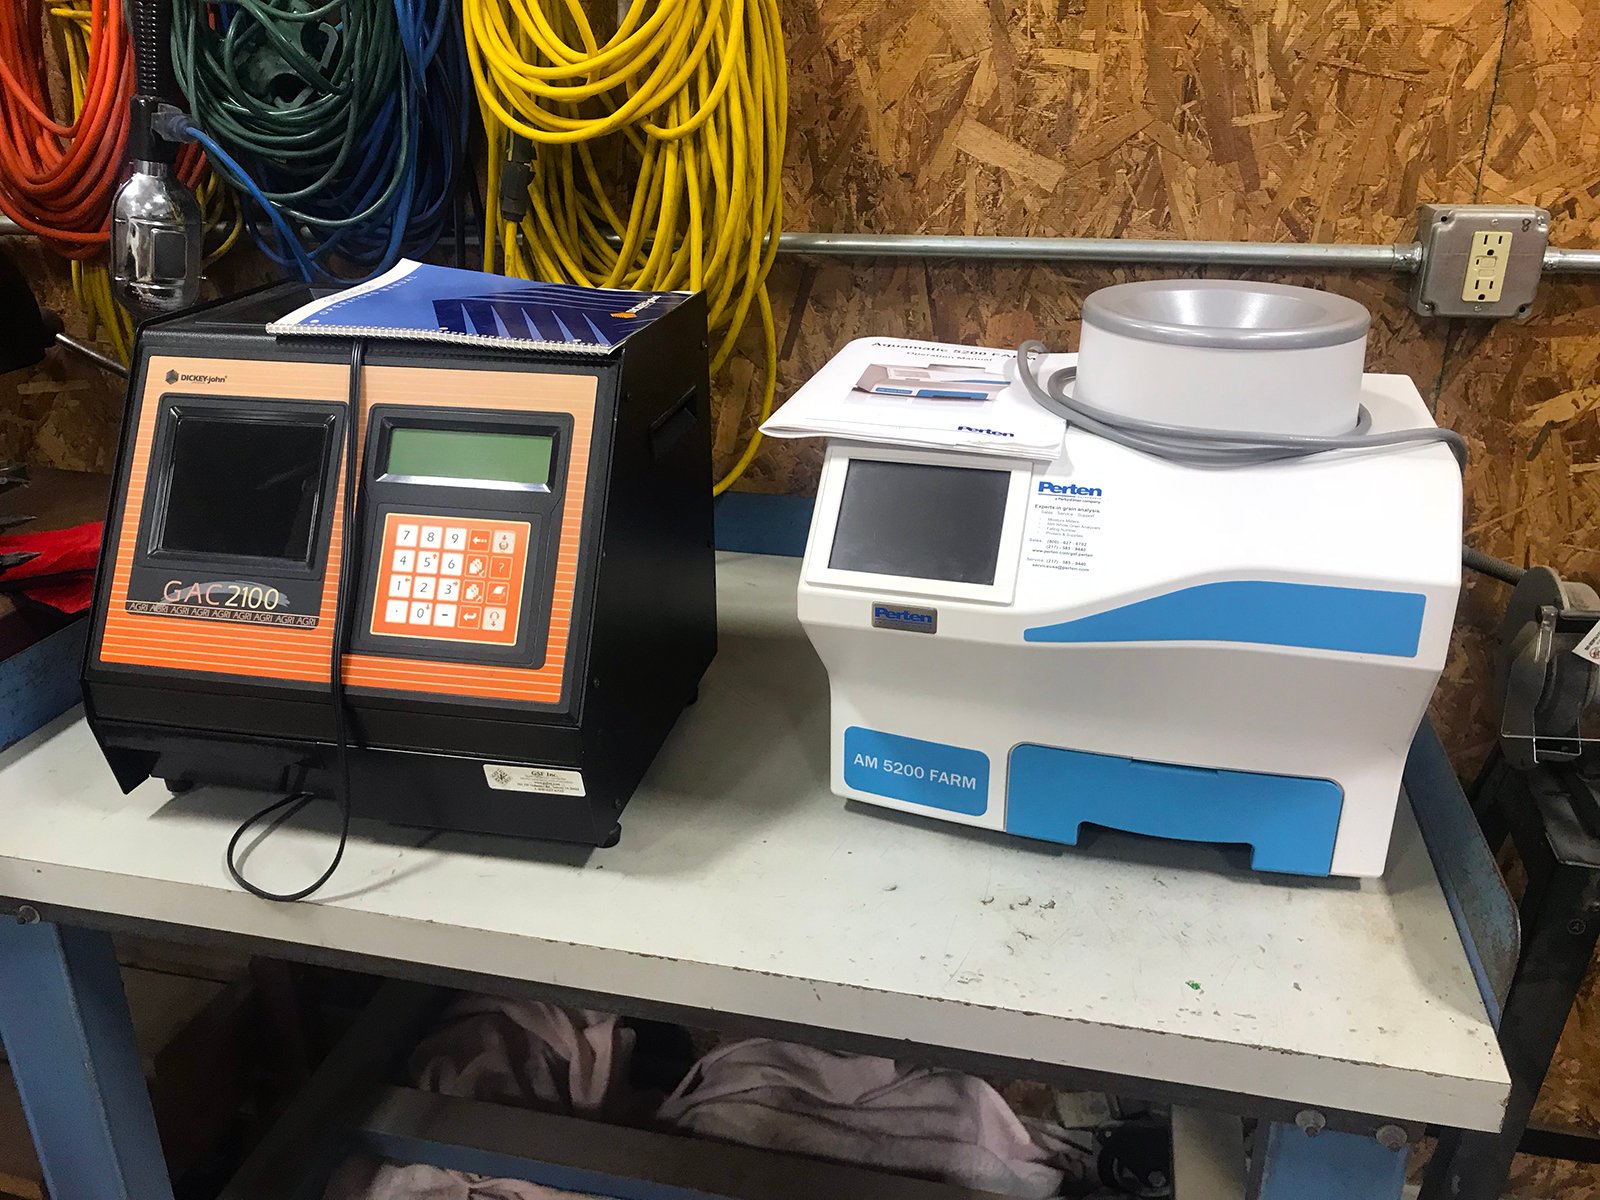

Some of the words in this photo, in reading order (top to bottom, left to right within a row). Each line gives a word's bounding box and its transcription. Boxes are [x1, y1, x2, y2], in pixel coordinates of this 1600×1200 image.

[1521, 218, 1532, 232] 8
[872, 342, 948, 353] Aquamatic
[906, 351, 954, 359] Operation
[957, 425, 1014, 437] Perten
[1038, 481, 1102, 497] Perten
[403, 530, 410, 541] 7
[427, 532, 435, 542] 8
[451, 533, 459, 544] 9
[400, 555, 407, 566] 4
[423, 557, 431, 568] 5
[447, 559, 455, 569] 6
[397, 580, 401, 591] 1
[420, 582, 428, 593] 2
[444, 584, 452, 595] 3
[130, 603, 148, 612] AGRI
[171, 606, 189, 615] AGRI
[191, 608, 210, 617] AGRI
[211, 609, 231, 619] AGRI
[233, 611, 251, 621] AGRI
[253, 613, 273, 623] AGRI
[275, 615, 294, 625] AGRI
[296, 617, 316, 626] AGRI
[417, 608, 425, 619] 0
[874, 606, 933, 623] Perten
[853, 753, 878, 769] AM
[883, 759, 925, 779] 5200
[929, 769, 977, 790] FARM
